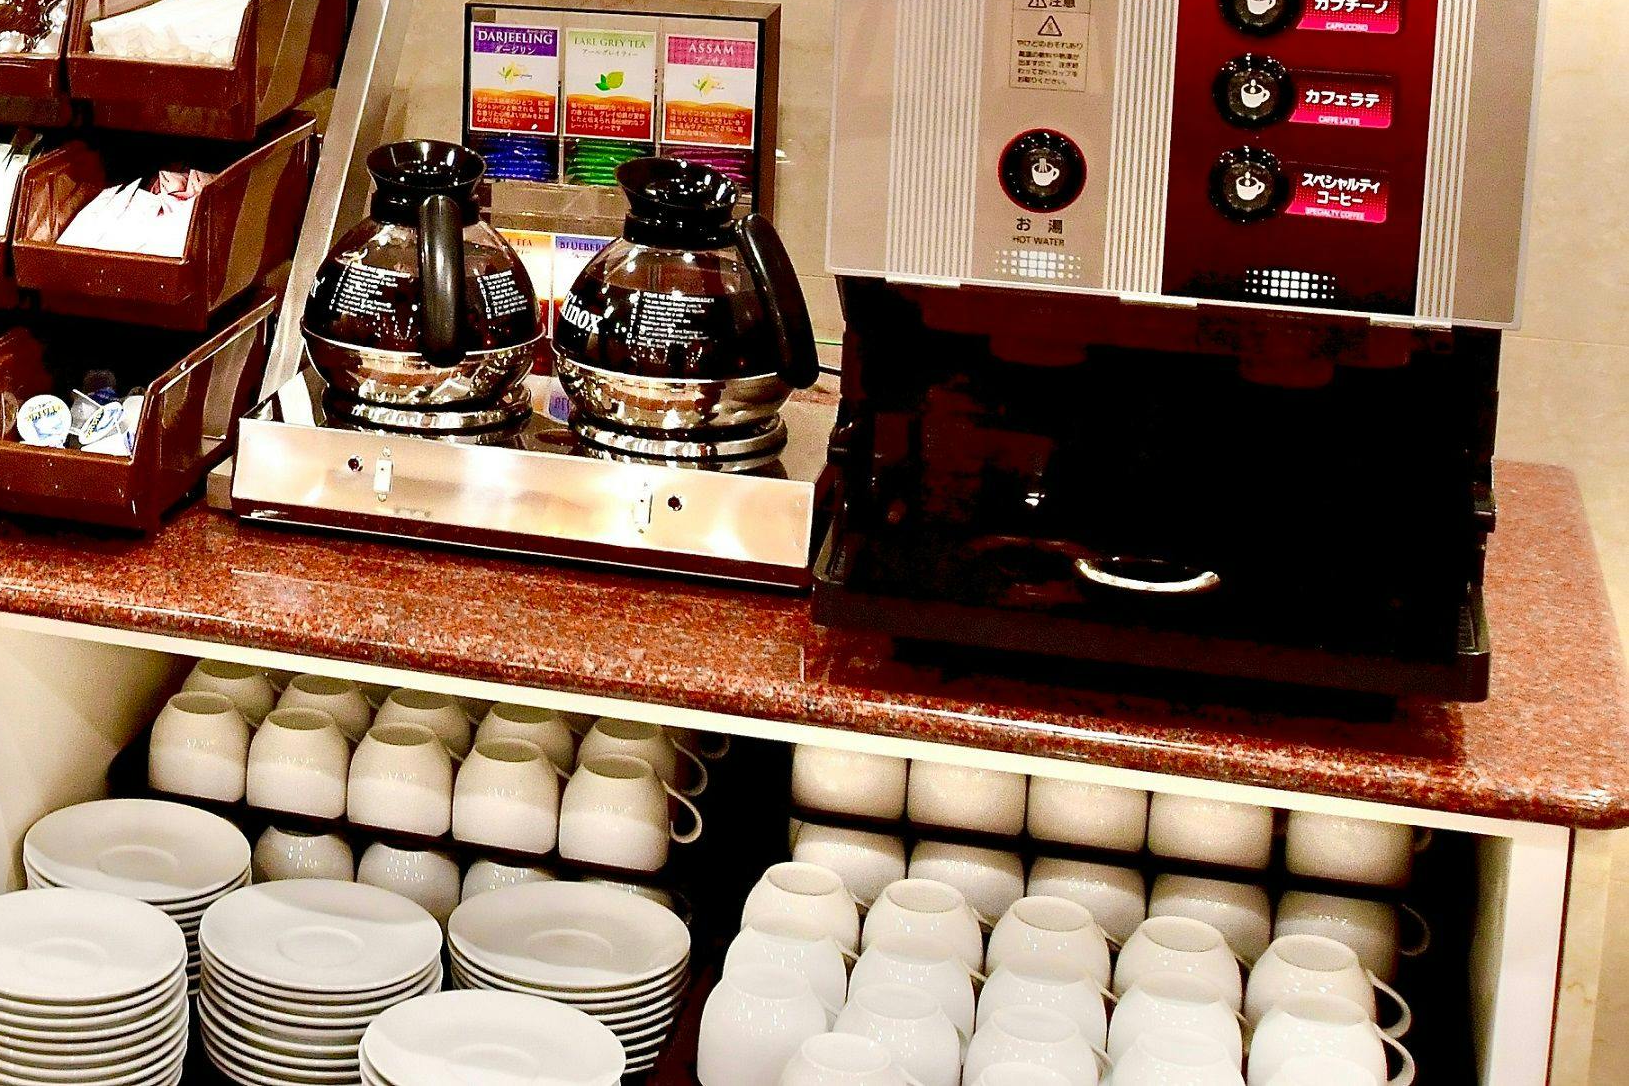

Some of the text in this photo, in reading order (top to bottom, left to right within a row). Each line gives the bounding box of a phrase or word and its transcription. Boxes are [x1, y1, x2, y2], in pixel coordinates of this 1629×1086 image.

[477, 30, 553, 45] DARJEELING
[628, 40, 646, 49] TEA
[688, 42, 734, 55] ASSAM
[1305, 88, 1380, 108] カフェラテ
[1301, 173, 1381, 194] スペシャルティ
[1317, 190, 1364, 207] コーヒー
[1012, 235, 1065, 246] HOT WATER
